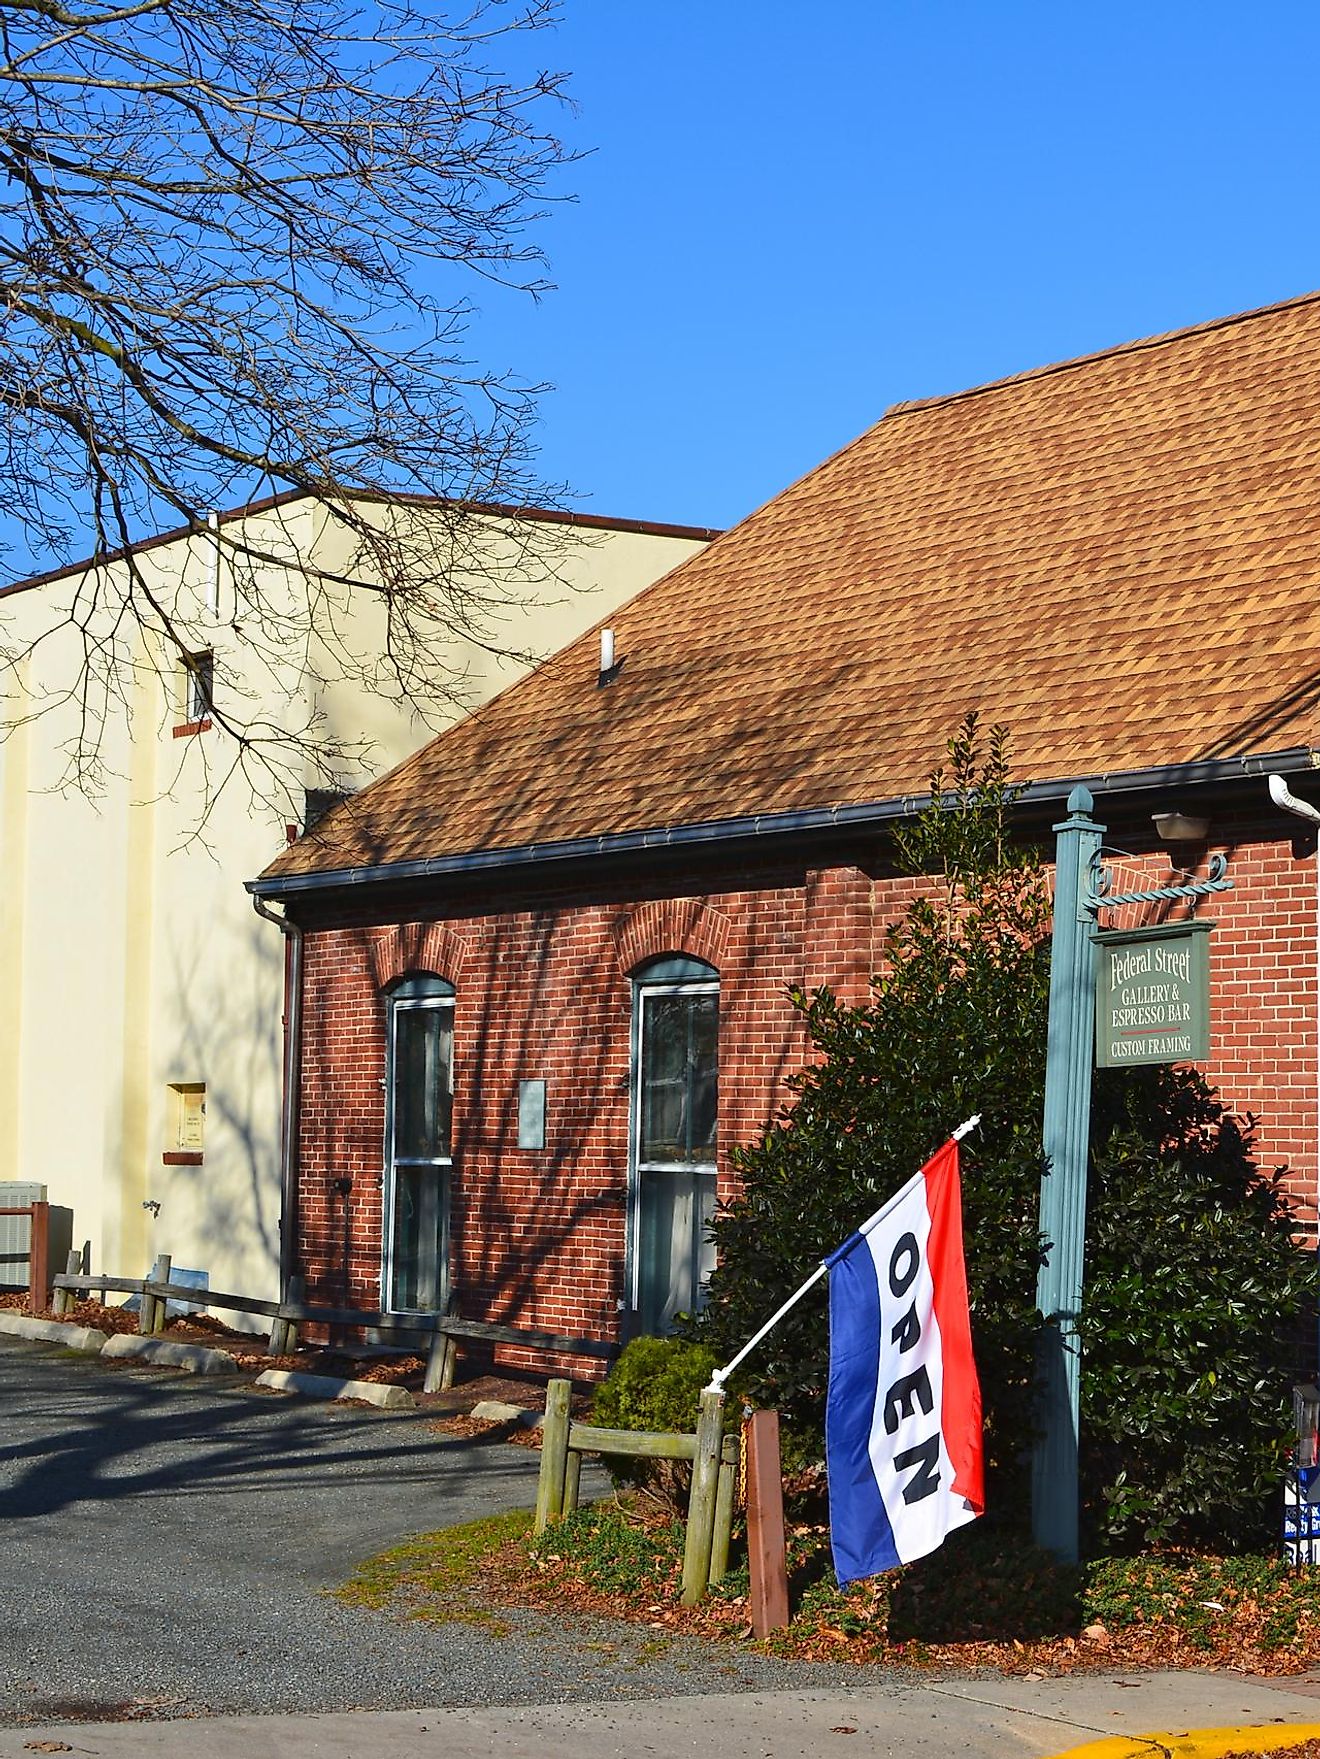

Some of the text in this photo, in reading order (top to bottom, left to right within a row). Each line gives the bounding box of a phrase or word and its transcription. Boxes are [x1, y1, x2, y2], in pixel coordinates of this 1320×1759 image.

[1110, 947, 1191, 992] Federal Street
[1121, 982, 1180, 1006] GALLERY &
[1112, 1002, 1191, 1028] ESPRESSO BAR
[1111, 1035, 1191, 1058] CUSTOM FRAMING
[884, 1231, 942, 1506] OPEN
